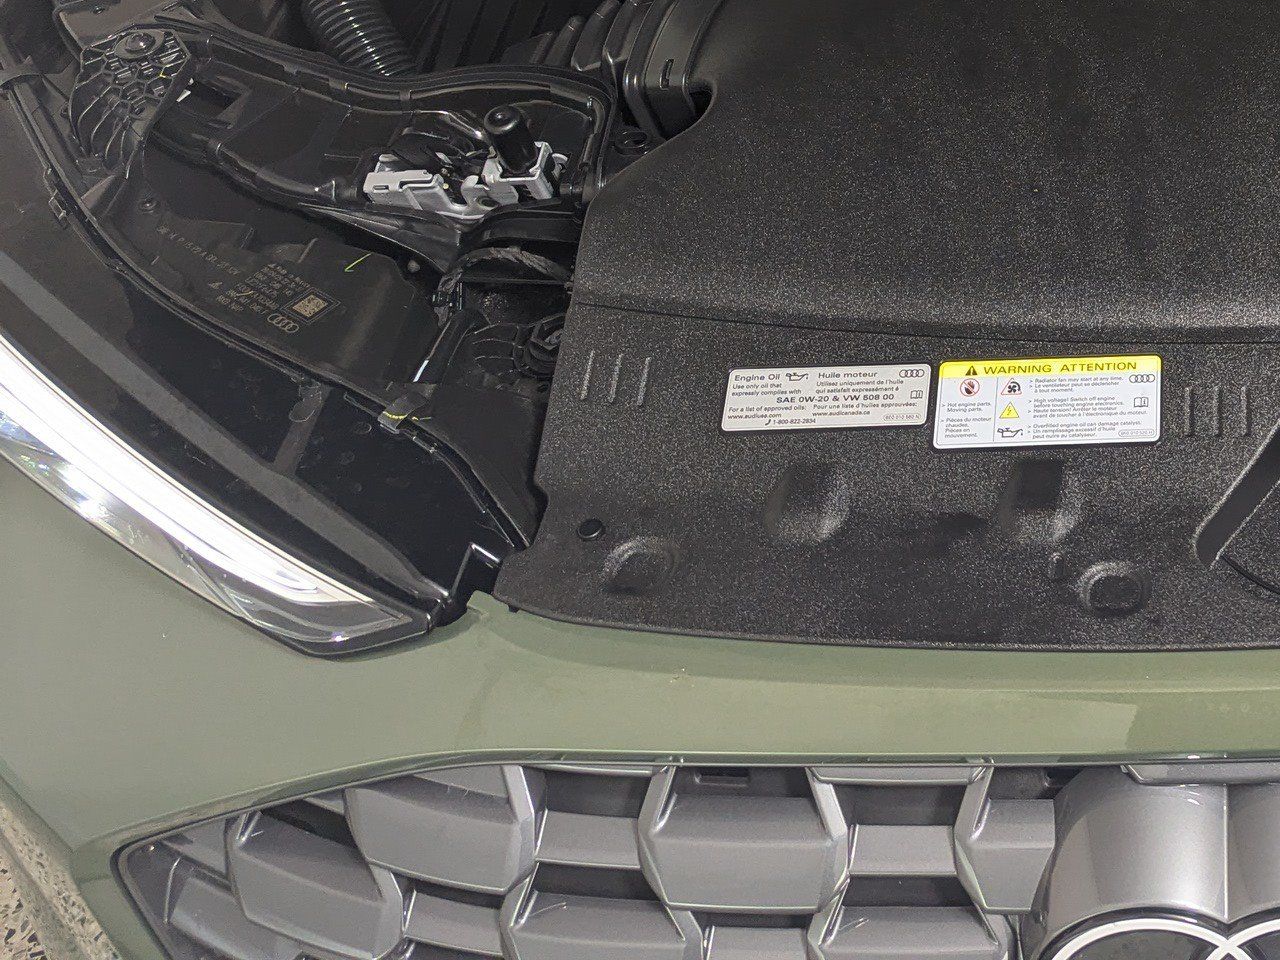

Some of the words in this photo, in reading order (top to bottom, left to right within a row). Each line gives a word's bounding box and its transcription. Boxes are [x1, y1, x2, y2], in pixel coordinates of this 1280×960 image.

[984, 365, 1052, 374] WARNING
[1060, 362, 1136, 372] ATTENTION
[735, 374, 765, 382] Engine
